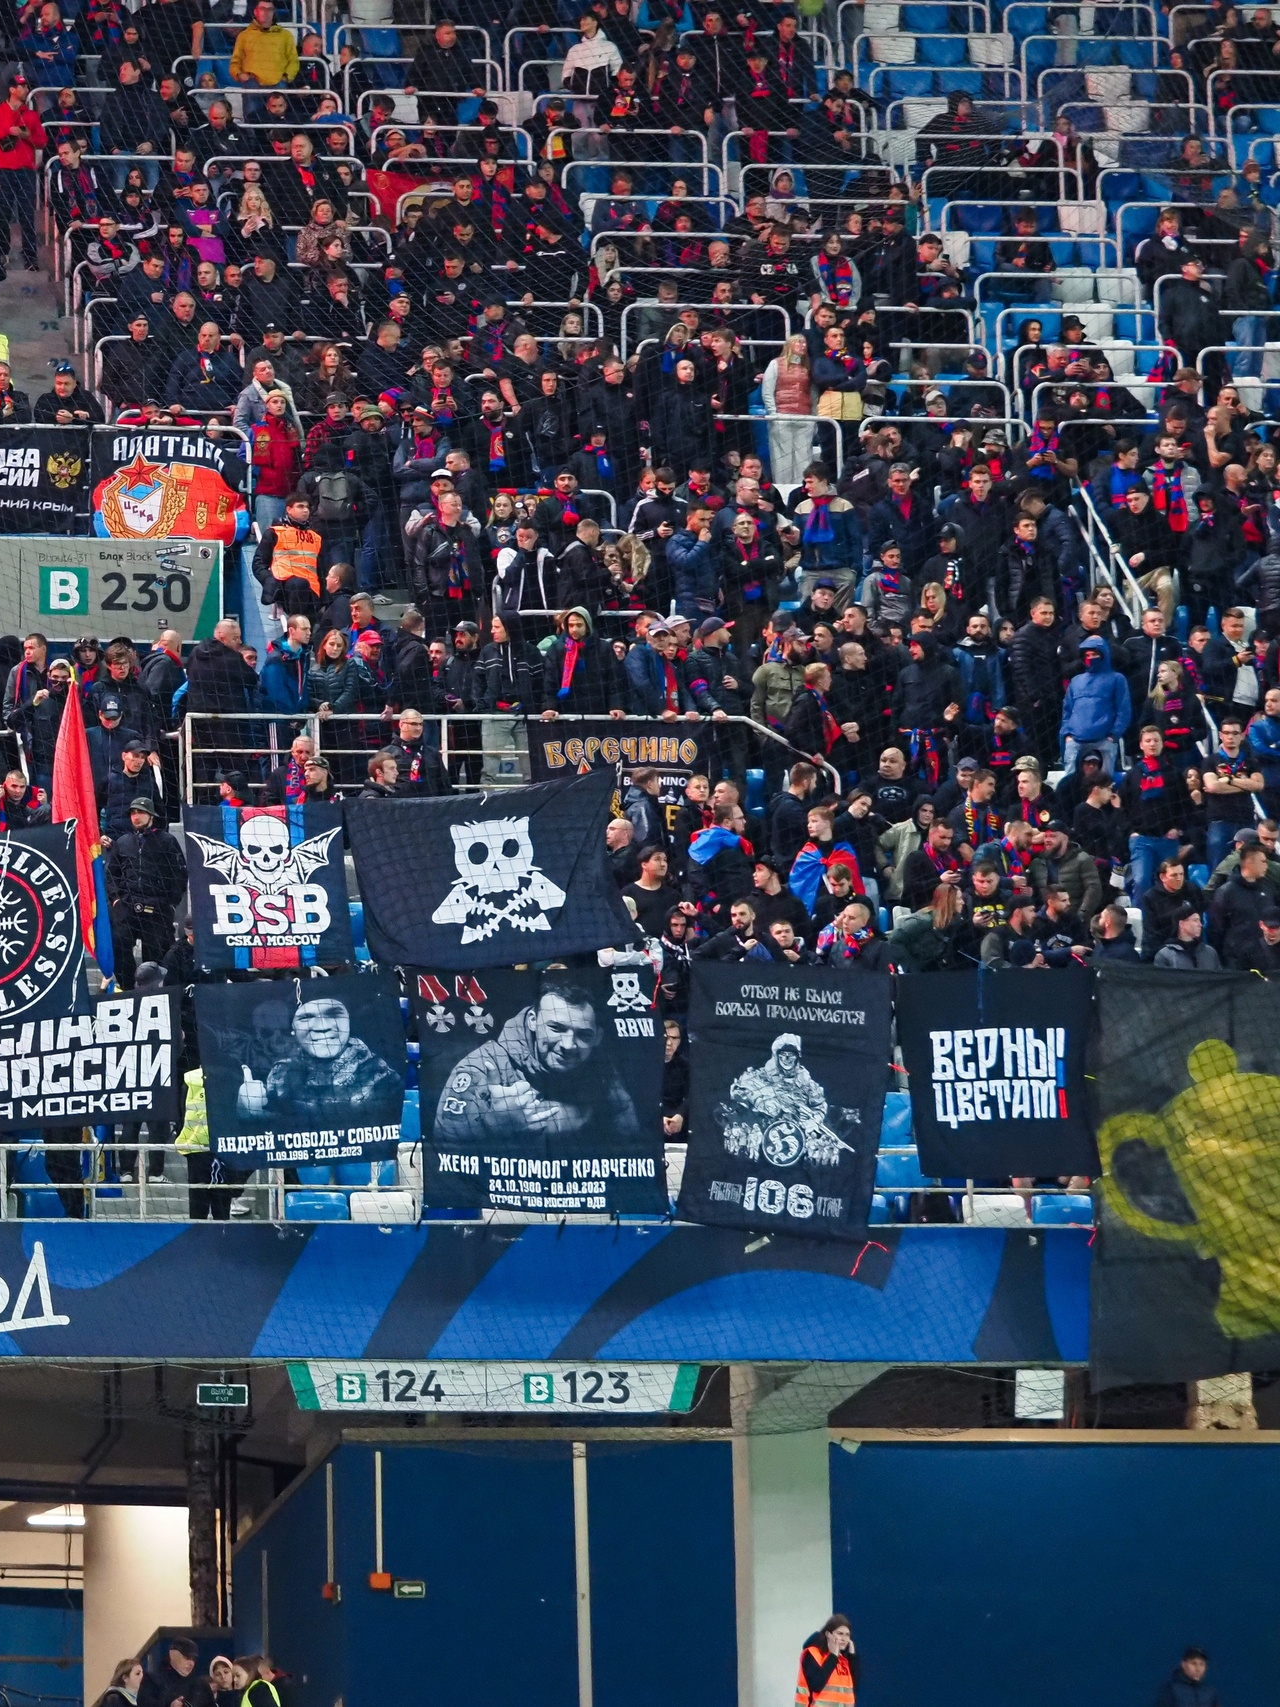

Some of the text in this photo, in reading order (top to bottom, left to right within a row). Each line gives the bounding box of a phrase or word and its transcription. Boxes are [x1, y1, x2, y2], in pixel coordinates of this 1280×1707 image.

[32, 501, 74, 513] КРЫМ
[99, 552, 124, 561] Блок
[100, 572, 191, 612] 230
[543, 736, 698, 769] БЕРЕЧИНО
[209, 883, 332, 934] BSB
[226, 934, 321, 947] CSKA MOSCOW
[741, 984, 779, 1000] ОТБОЯ
[784, 987, 800, 1001] НЕ
[614, 1018, 655, 1037] RBW
[715, 1001, 865, 1025] БОРЬБА ПРОДОЛЖАЕТСЯ!
[929, 1028, 1056, 1080] ВЕРНЫ
[22, 1090, 154, 1120] МОСКВА
[932, 1079, 1057, 1129] ЦВЕТАМ
[218, 1123, 402, 1154] АНДРЕЙ "СОБОЛЬ" СОБОЛЕ
[438, 1153, 656, 1180] ЖЕНЯ "БОГОМОЛ" КРАВЧЕНКО
[743, 1176, 815, 1219] 106
[375, 1370, 445, 1403] 124
[562, 1371, 631, 1404] 123
